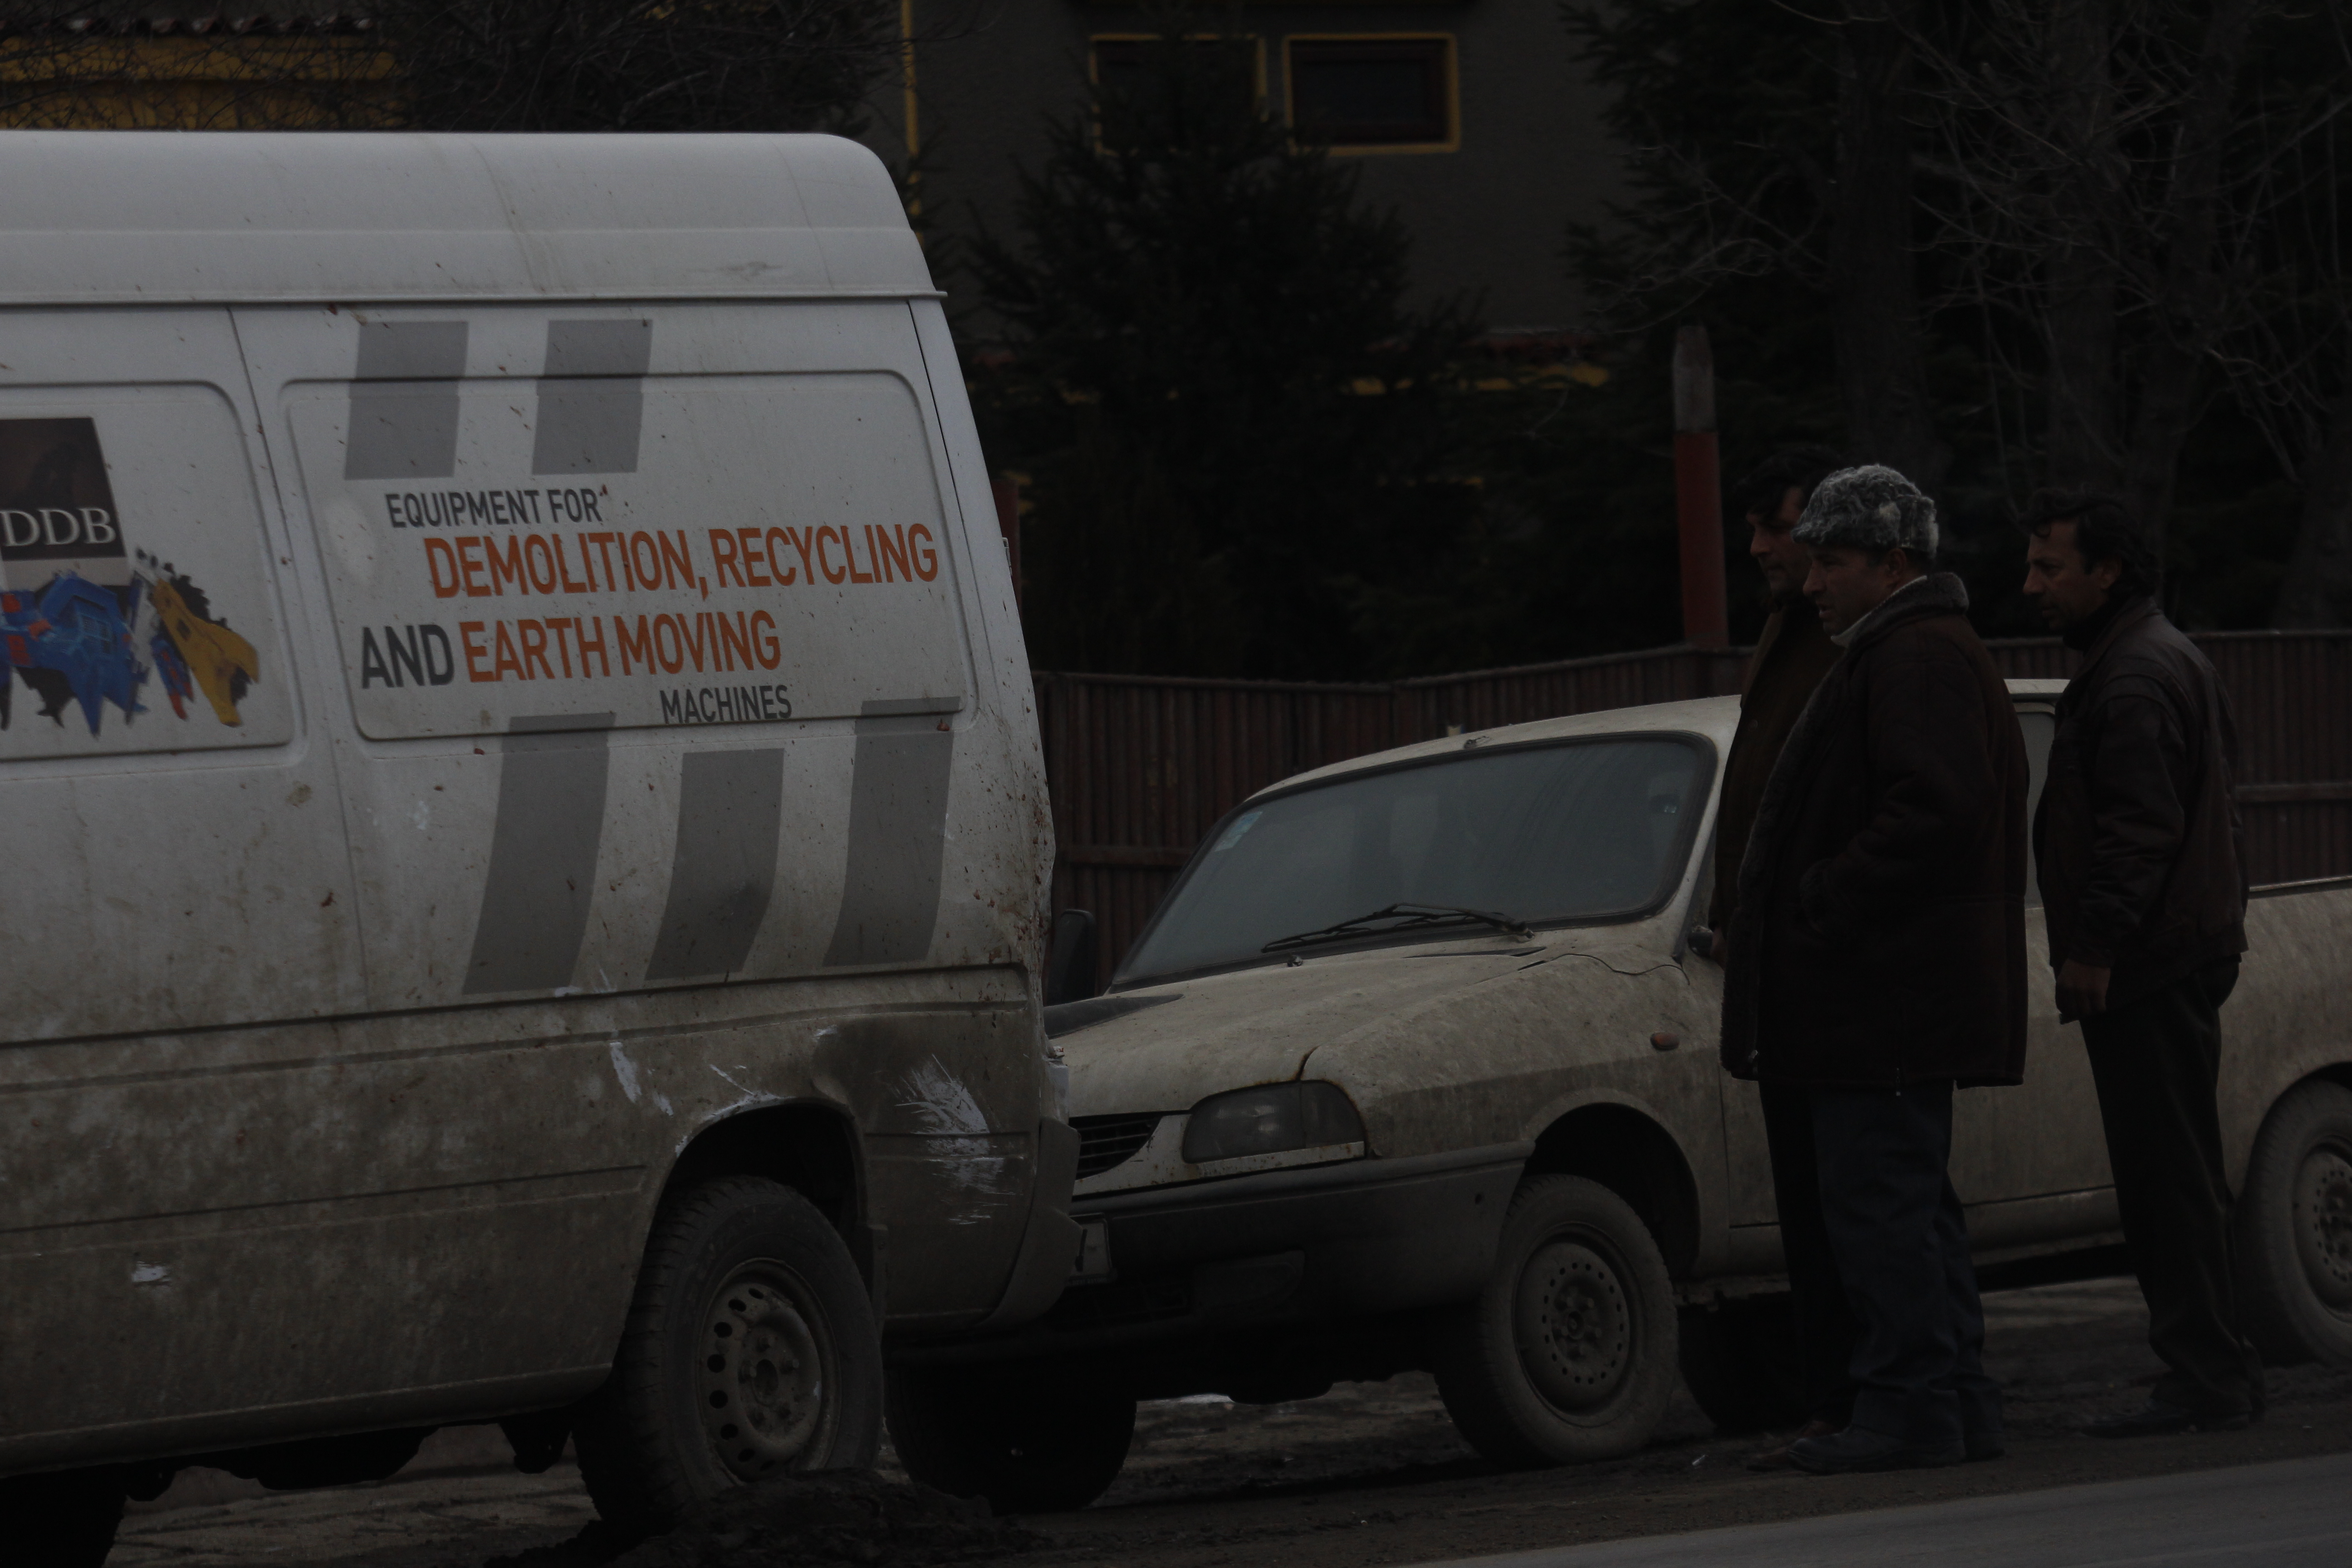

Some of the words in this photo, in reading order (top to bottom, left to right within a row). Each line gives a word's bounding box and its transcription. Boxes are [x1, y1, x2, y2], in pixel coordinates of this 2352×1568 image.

[0, 507, 116, 547] DDB
[385, 490, 542, 528] EQUIPMENT
[546, 489, 603, 523] FOR
[424, 529, 709, 601] DEMOLITION,
[708, 523, 938, 588] RECYCLING
[362, 624, 455, 690] AND
[459, 616, 611, 683] EARTH
[613, 610, 781, 676] MOVING
[659, 684, 793, 725] MACHINES
